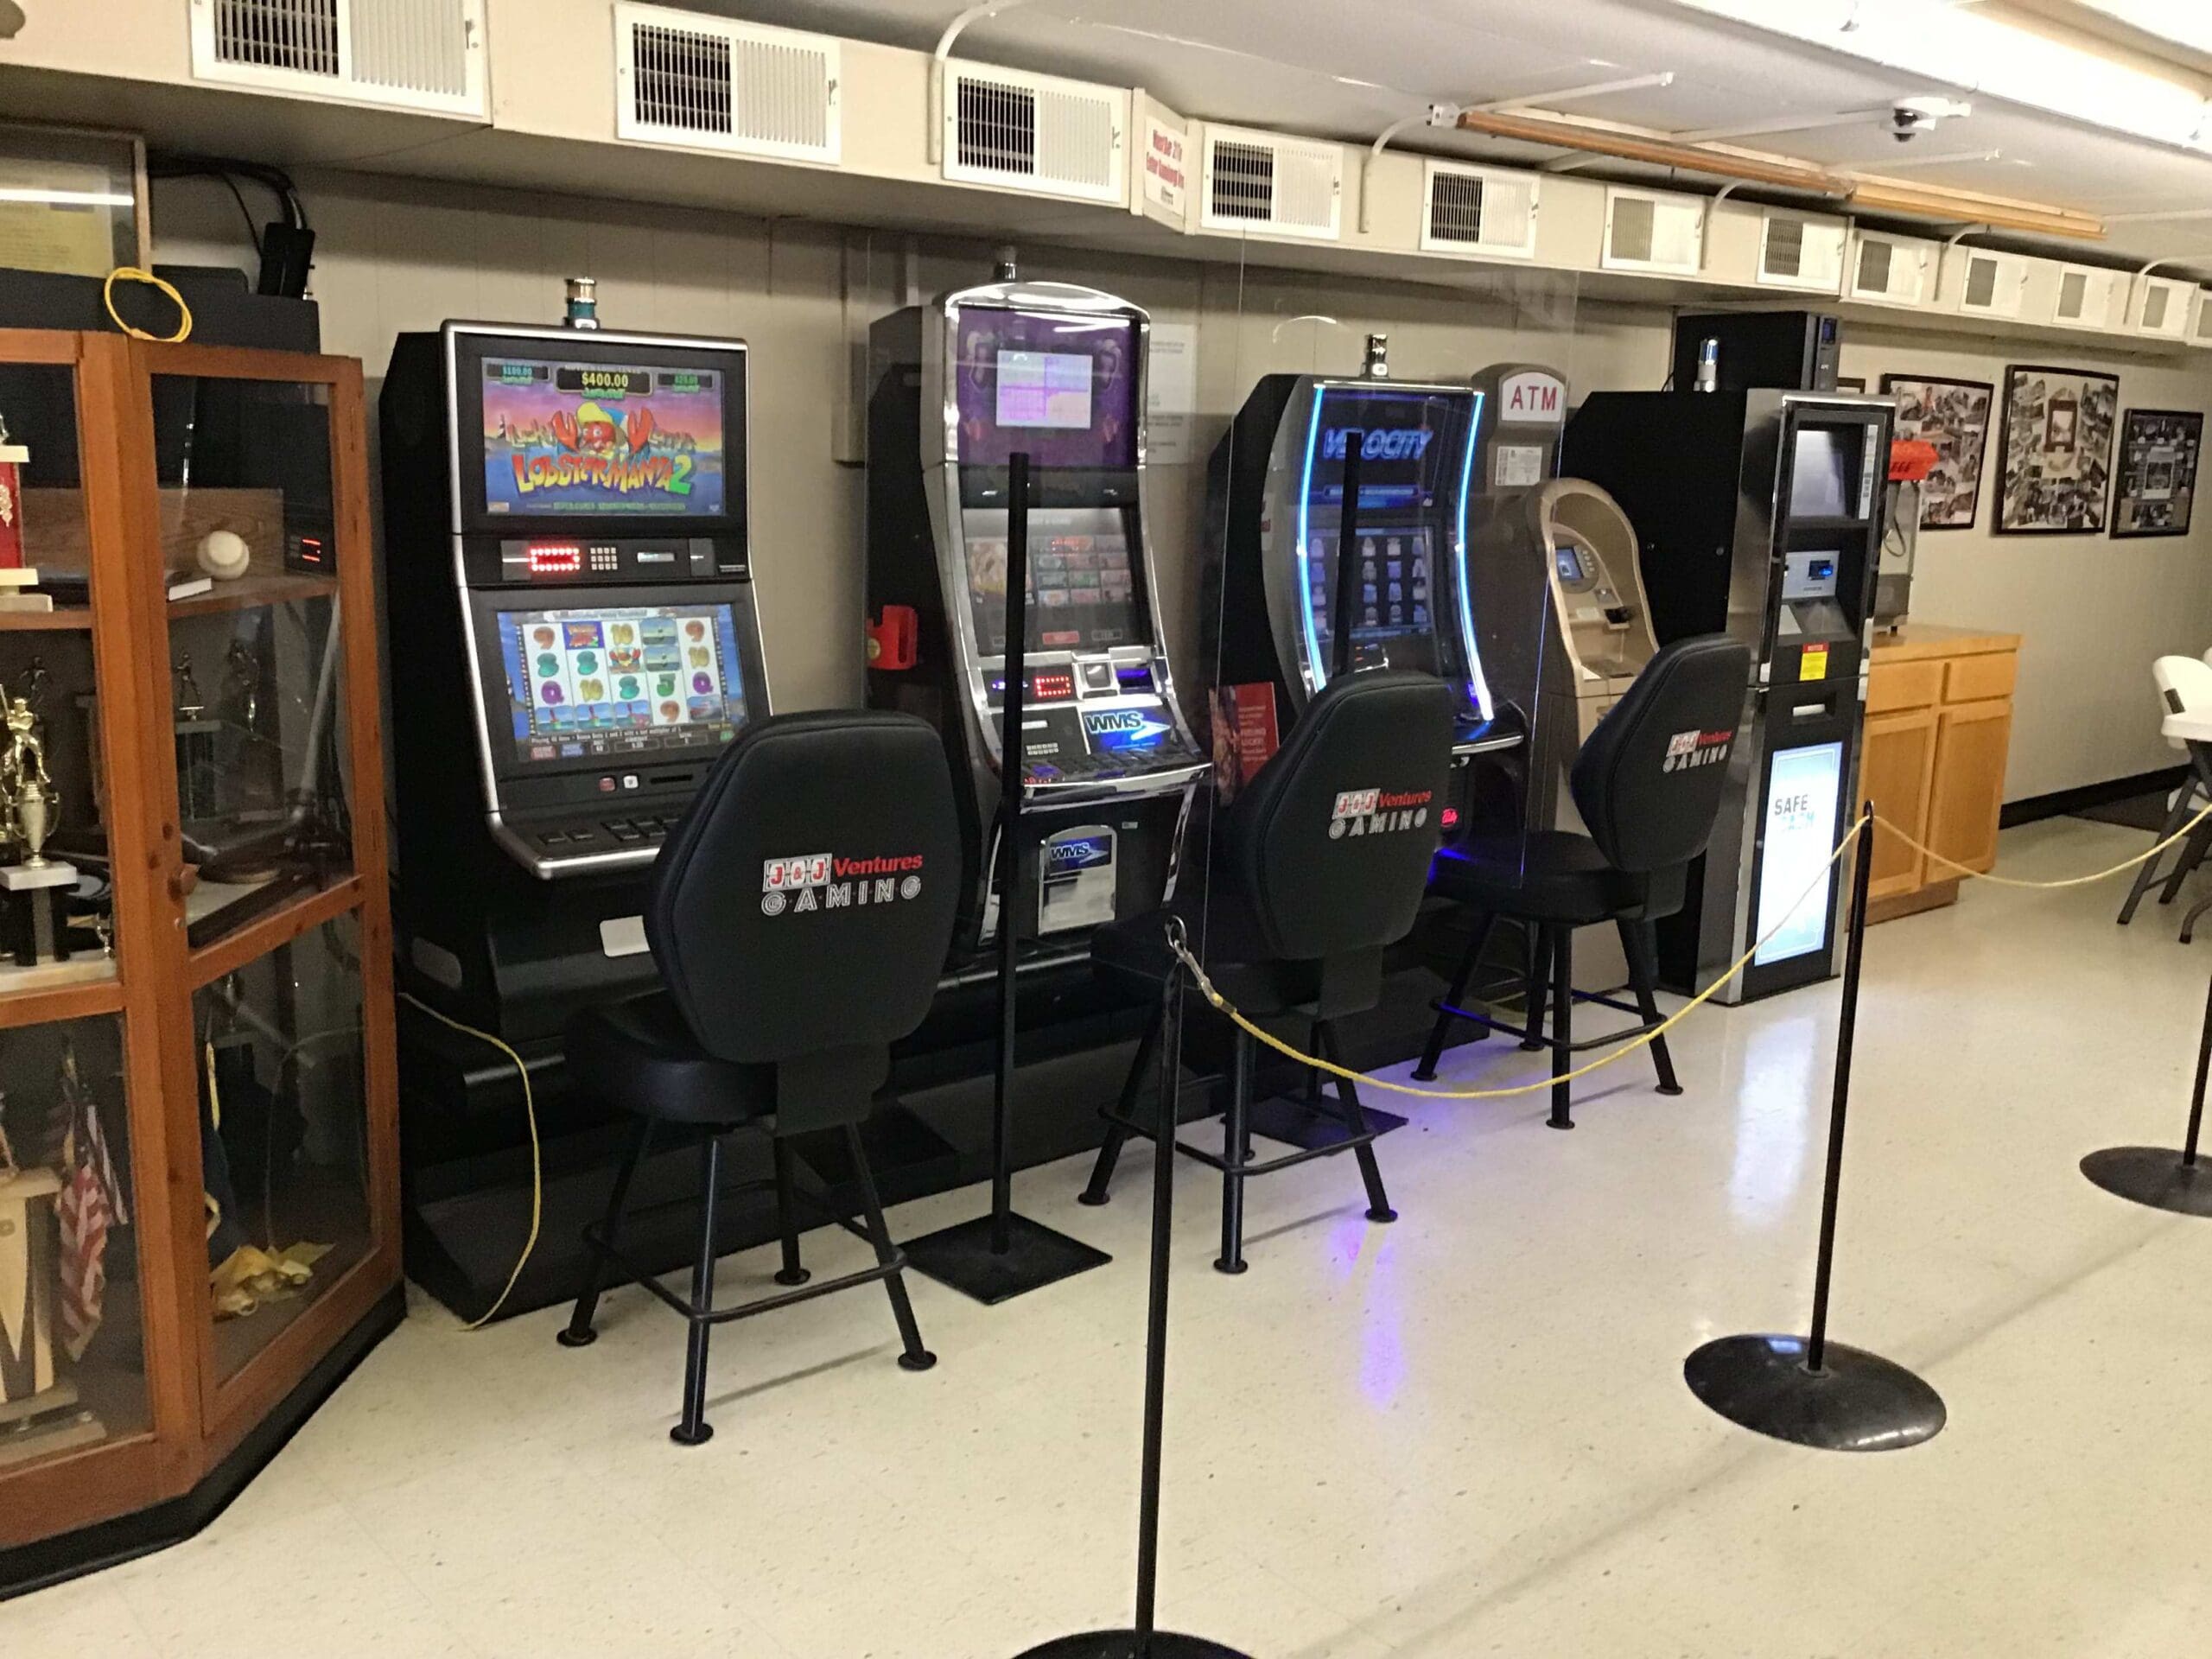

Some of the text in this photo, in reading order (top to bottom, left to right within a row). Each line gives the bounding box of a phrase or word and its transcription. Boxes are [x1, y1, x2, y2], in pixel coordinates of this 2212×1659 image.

[582, 372, 629, 387] $400.00
[1510, 385, 1558, 411] ATM
[1084, 710, 1143, 734] WMS
[1379, 790, 1432, 808] Ventures
[1774, 793, 1808, 816] SAFE
[1050, 842, 1090, 861] WMS
[768, 855, 924, 887] J&J Ventures
